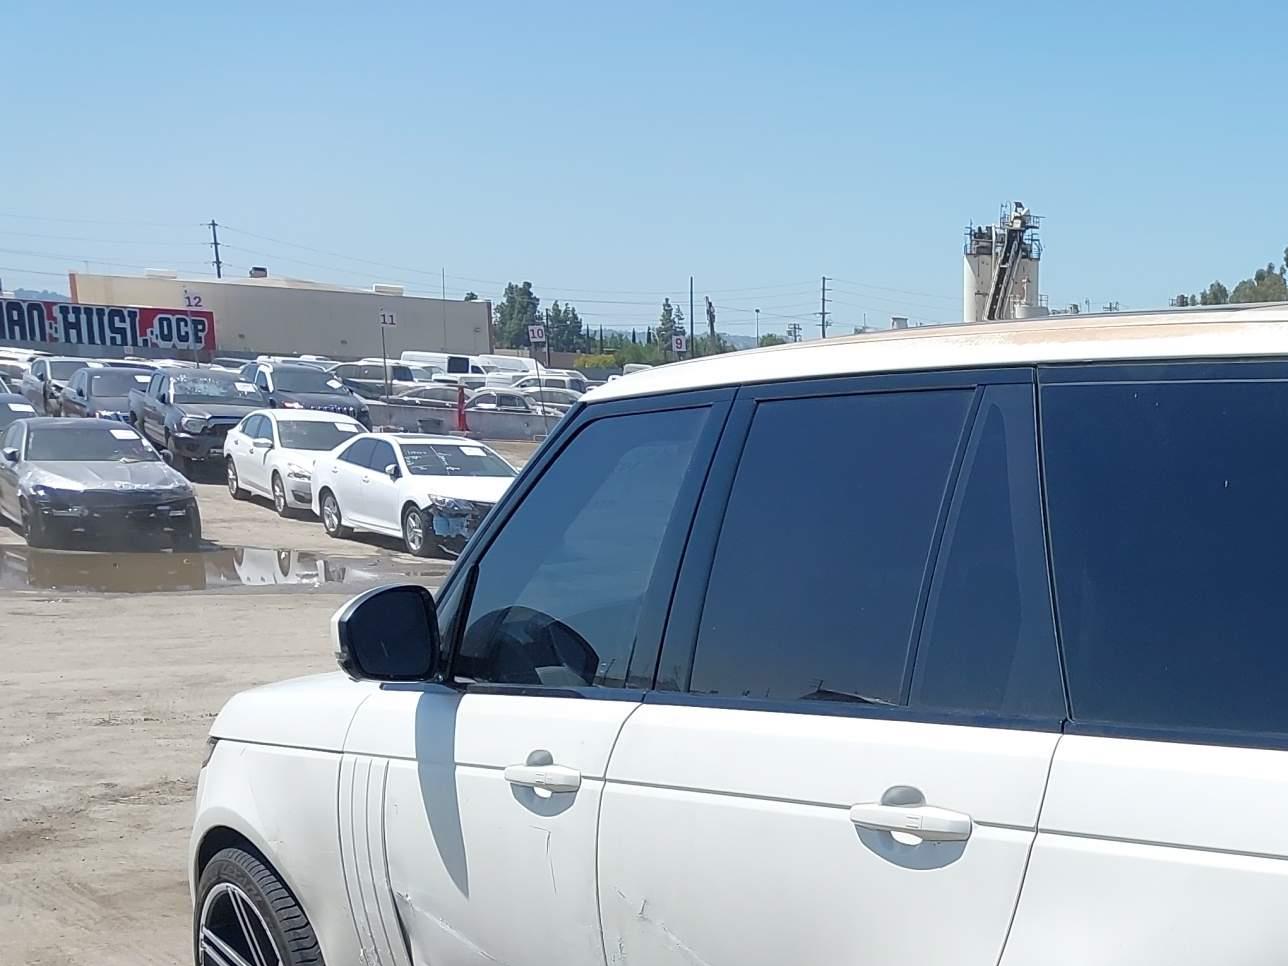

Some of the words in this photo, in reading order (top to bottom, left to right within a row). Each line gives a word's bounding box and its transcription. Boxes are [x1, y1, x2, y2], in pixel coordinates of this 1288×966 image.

[186, 295, 204, 308] 12
[380, 313, 397, 326] 11
[530, 328, 545, 340] 10
[675, 337, 684, 350] 9
